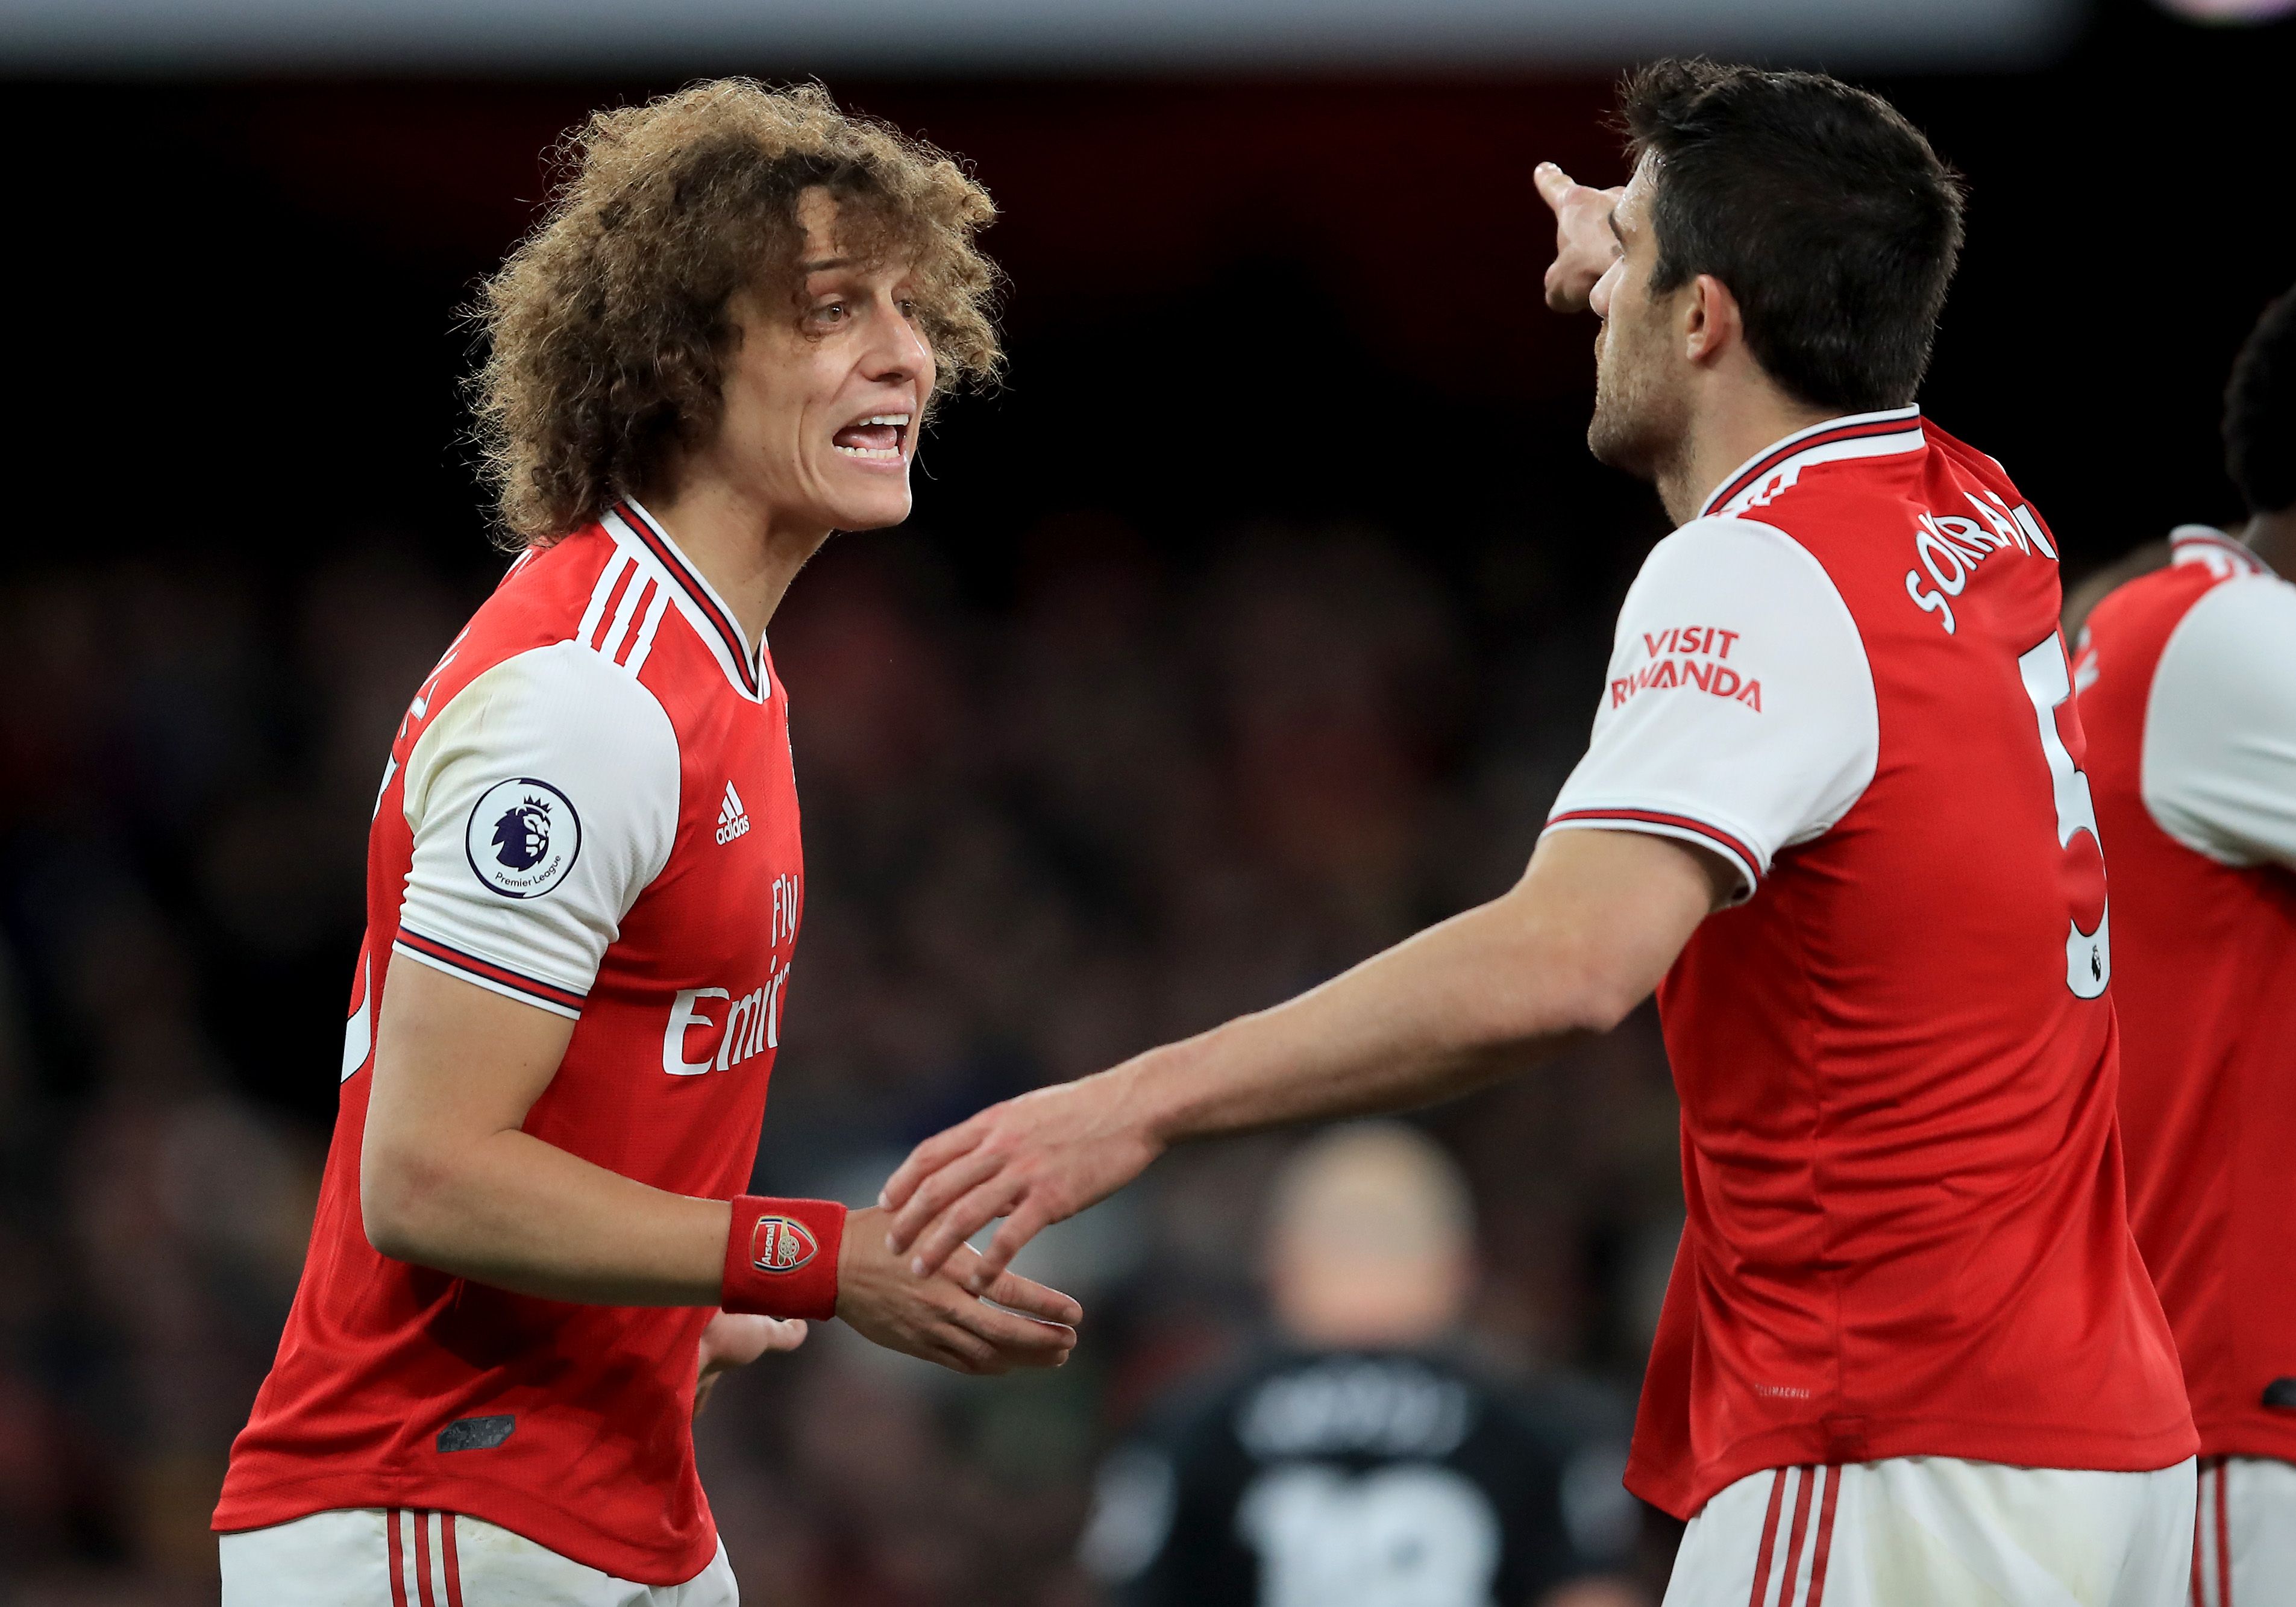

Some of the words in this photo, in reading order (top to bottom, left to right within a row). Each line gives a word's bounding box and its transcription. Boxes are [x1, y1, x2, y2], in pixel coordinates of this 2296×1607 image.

[1643, 626, 1739, 659] VISIT
[1611, 660, 1761, 713] RWANDA
[716, 814, 750, 845] adidas
[2018, 630, 2112, 1000] 5
[495, 871, 532, 887] Premier
[533, 855, 561, 884] League
[771, 872, 798, 948] Fly
[662, 954, 791, 1076] Emir
[761, 1224, 776, 1265] Arsenal
